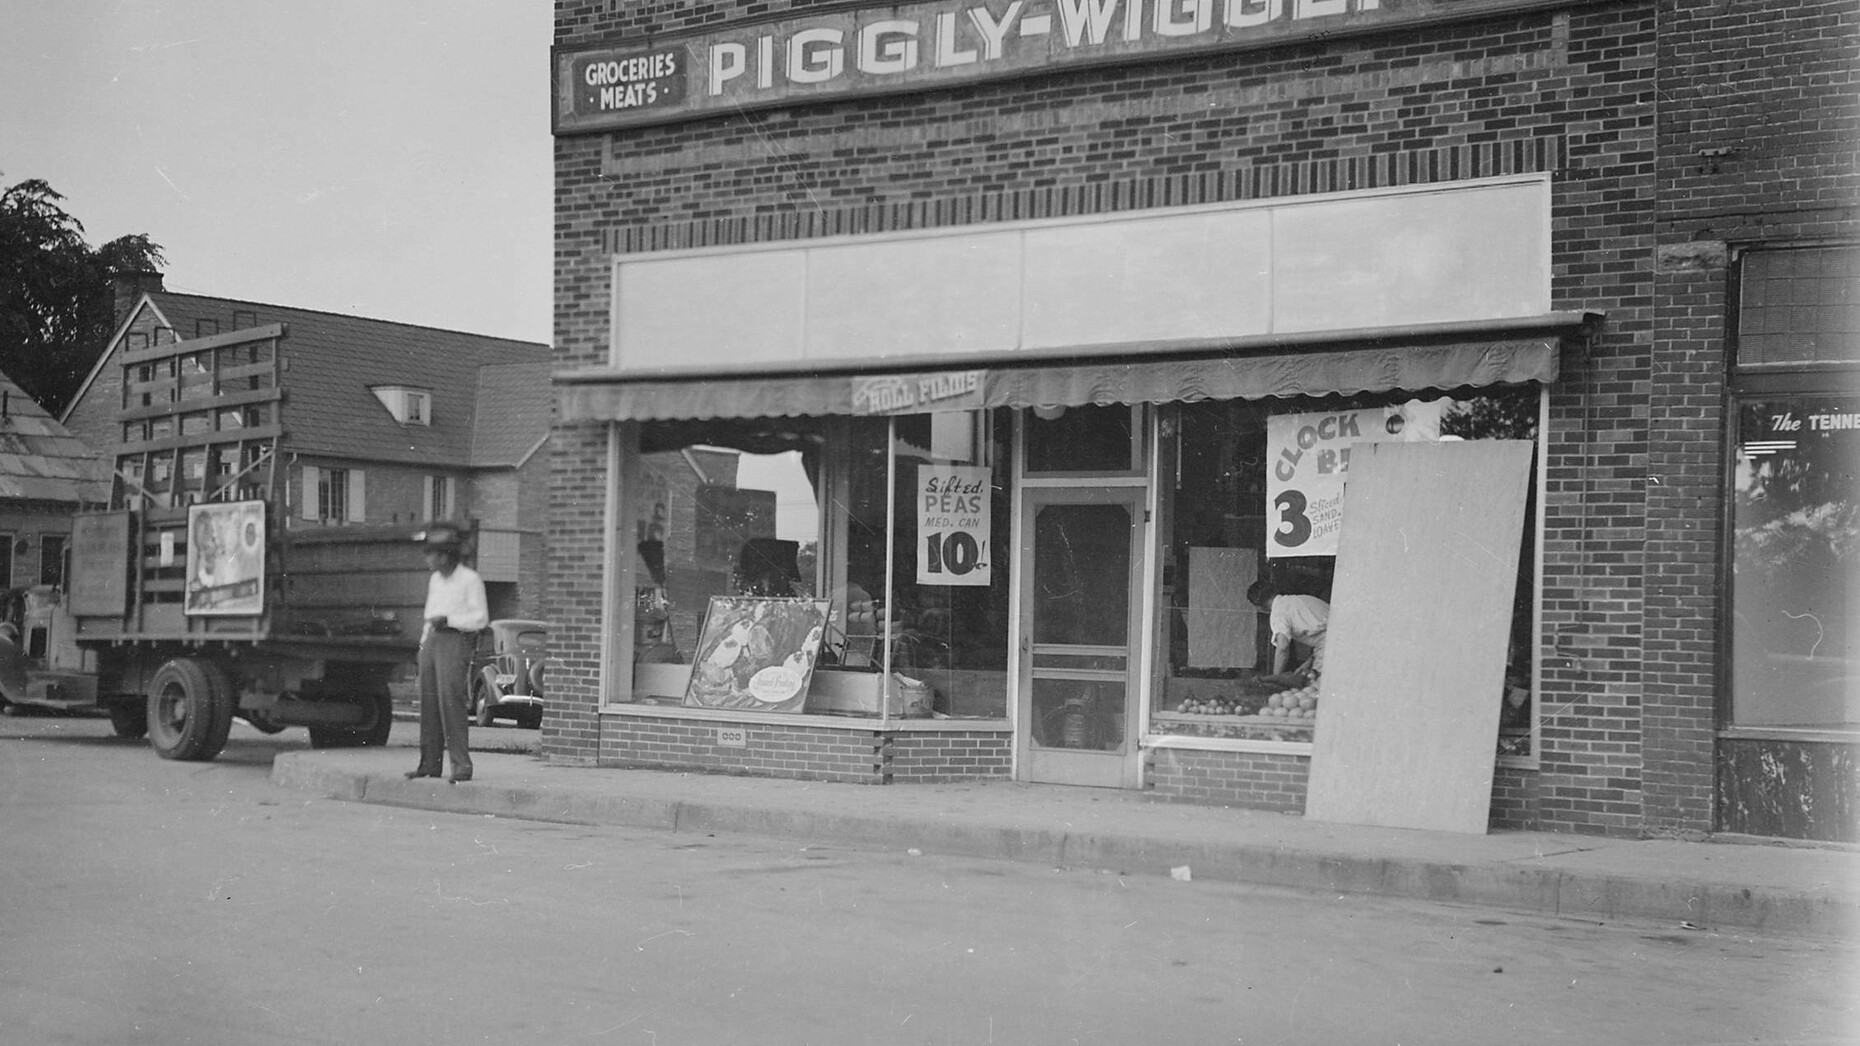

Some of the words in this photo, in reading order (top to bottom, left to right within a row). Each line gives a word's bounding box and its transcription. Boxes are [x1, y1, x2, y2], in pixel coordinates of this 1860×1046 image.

[708, 0, 1379, 96] PIGGLY-WIGG
[585, 53, 675, 86] GROCERIES
[600, 80, 656, 110] MEATS
[1771, 412, 1801, 431] The
[1275, 413, 1361, 482] CLOCK
[924, 495, 982, 514] PEAS
[1274, 489, 1312, 548] 3
[924, 516, 955, 528] MED.
[958, 516, 981, 528] CAN
